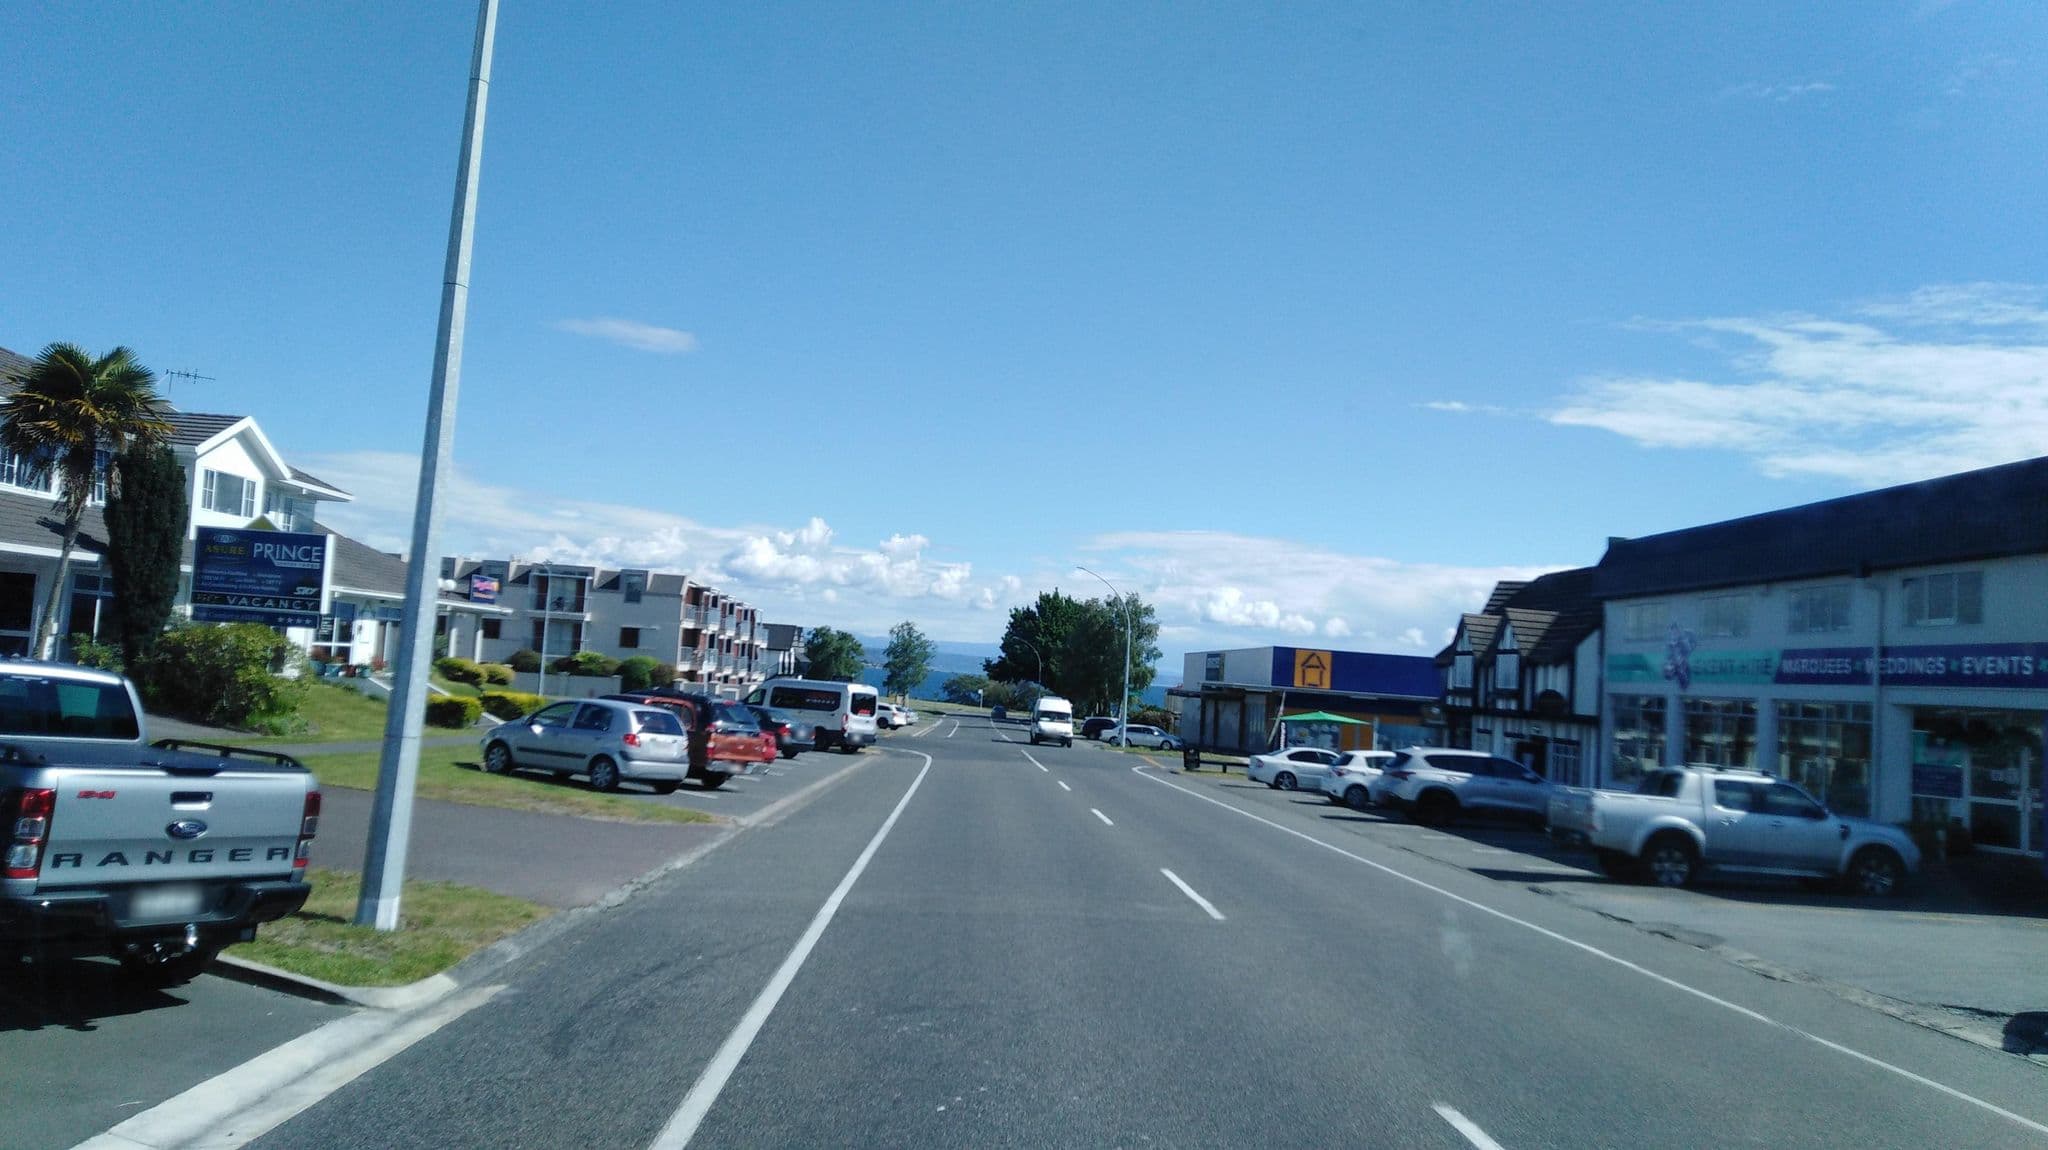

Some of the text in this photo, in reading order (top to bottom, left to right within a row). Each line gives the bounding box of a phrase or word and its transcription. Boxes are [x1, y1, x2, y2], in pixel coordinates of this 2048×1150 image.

[253, 543, 321, 561] PRINCE
[226, 596, 315, 610] VACANCY
[1782, 657, 1852, 675] MARQUEES
[1961, 656, 2034, 676] EVENTS
[51, 847, 290, 869] RANGER
